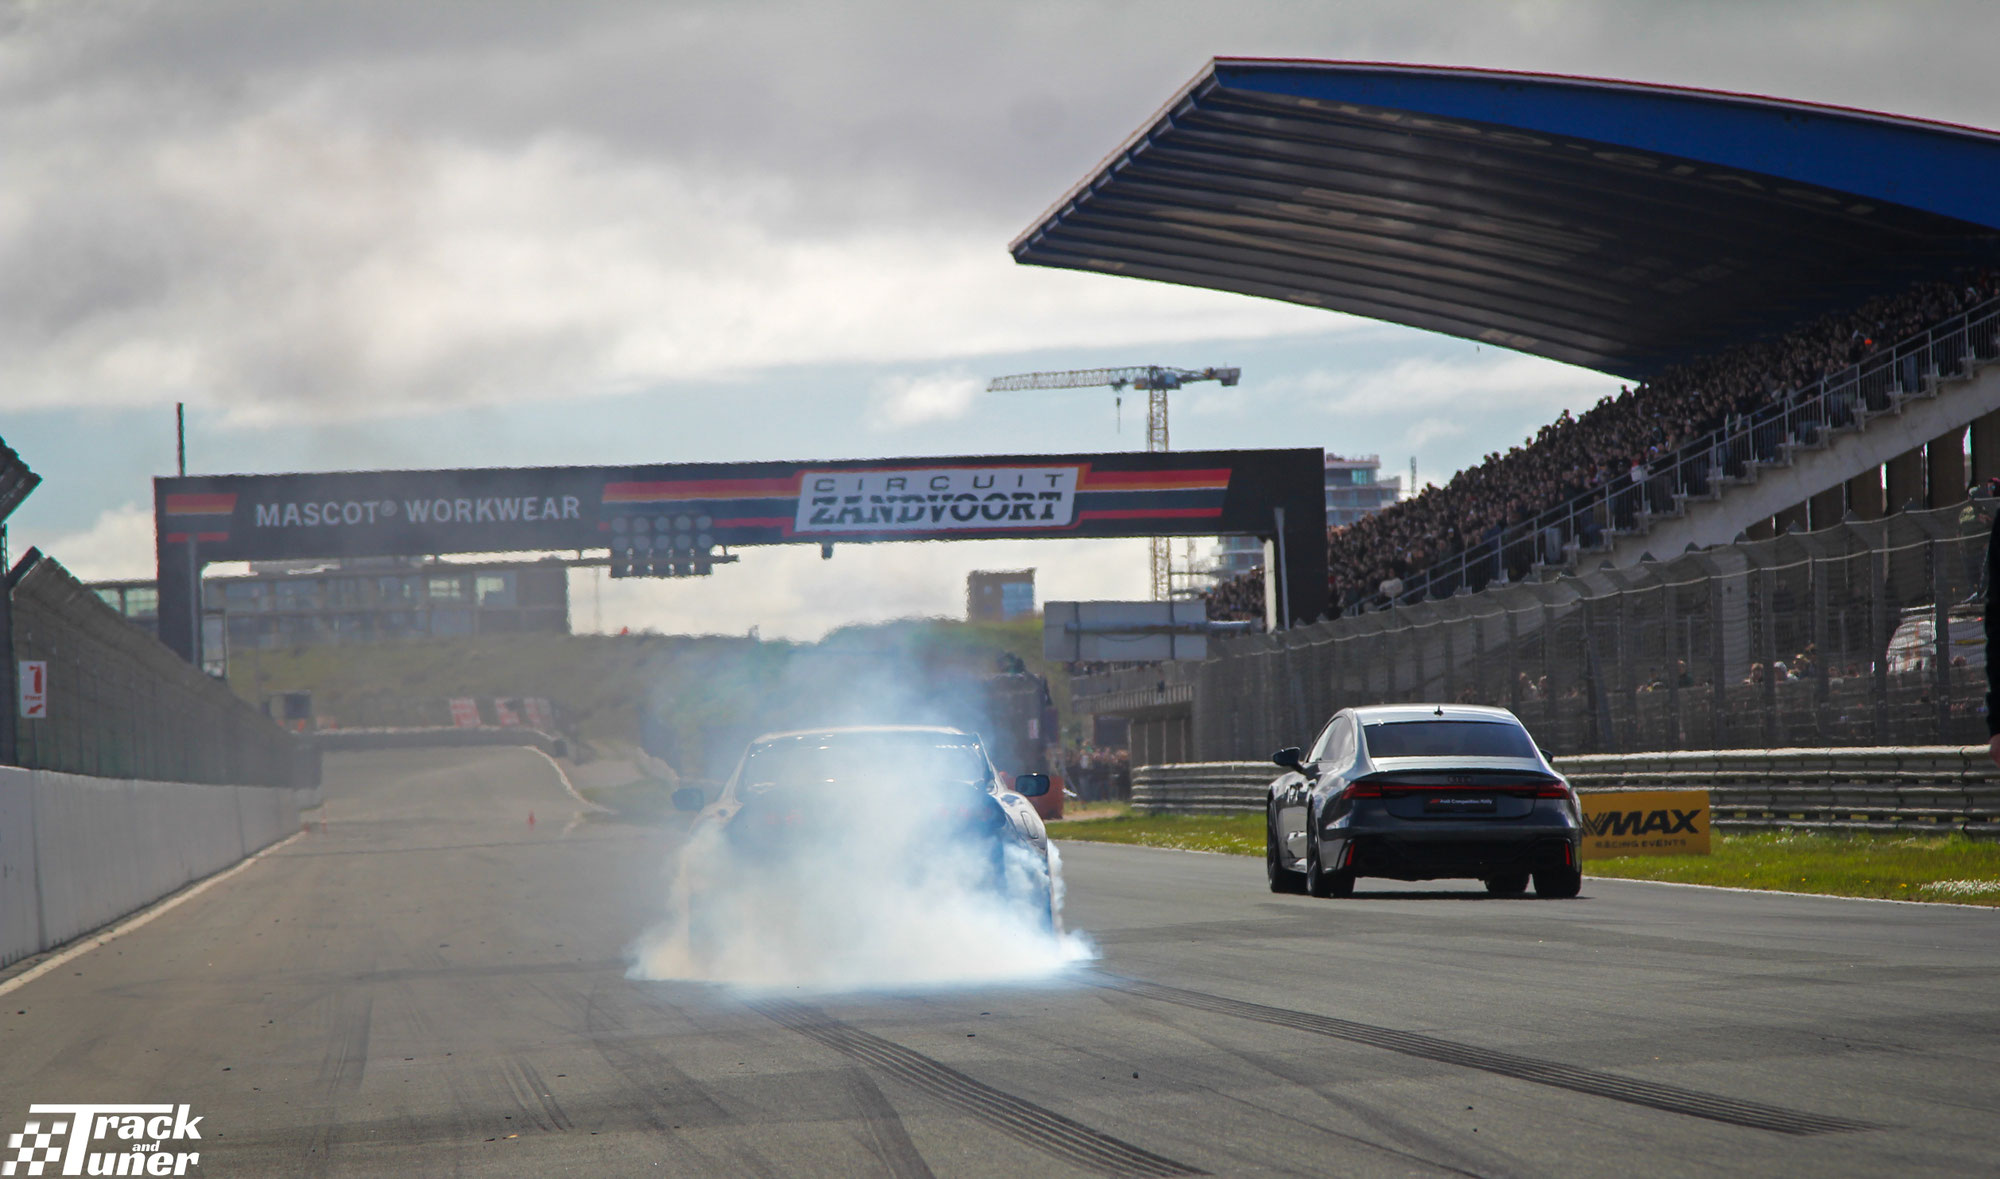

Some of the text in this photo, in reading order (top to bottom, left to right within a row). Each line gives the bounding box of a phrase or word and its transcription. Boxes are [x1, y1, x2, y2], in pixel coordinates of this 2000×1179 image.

[813, 474, 1064, 492] CIRCUIT
[404, 495, 580, 524] WORKWEAR
[809, 491, 1062, 525] ZANDVOORT
[1641, 838, 1686, 848] EVENTS
